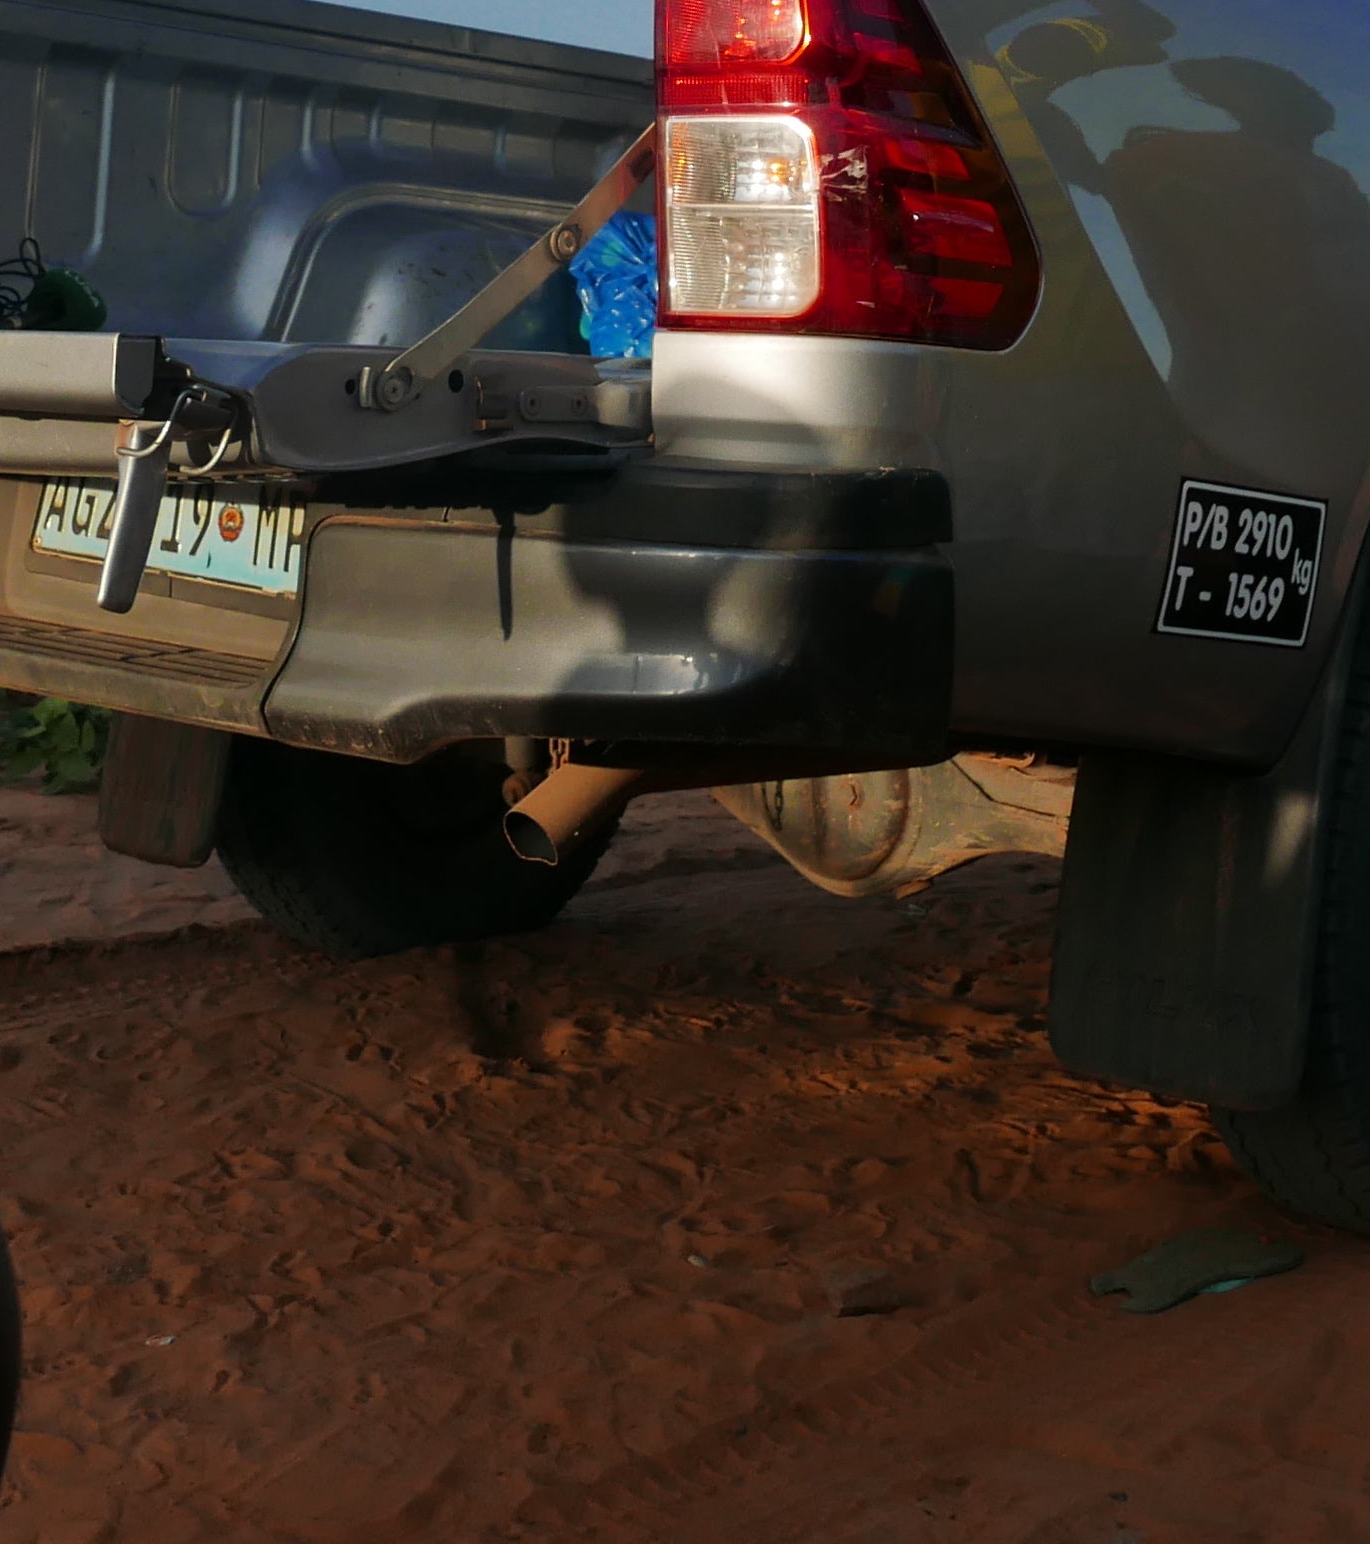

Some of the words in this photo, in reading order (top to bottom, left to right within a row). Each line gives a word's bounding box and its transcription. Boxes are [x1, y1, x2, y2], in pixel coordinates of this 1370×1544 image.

[1183, 501, 1229, 551] P/B
[1234, 508, 1294, 561] 2910
[1175, 565, 1194, 612] T
[1225, 572, 1285, 623] 1569
[1291, 547, 1313, 596] kg
